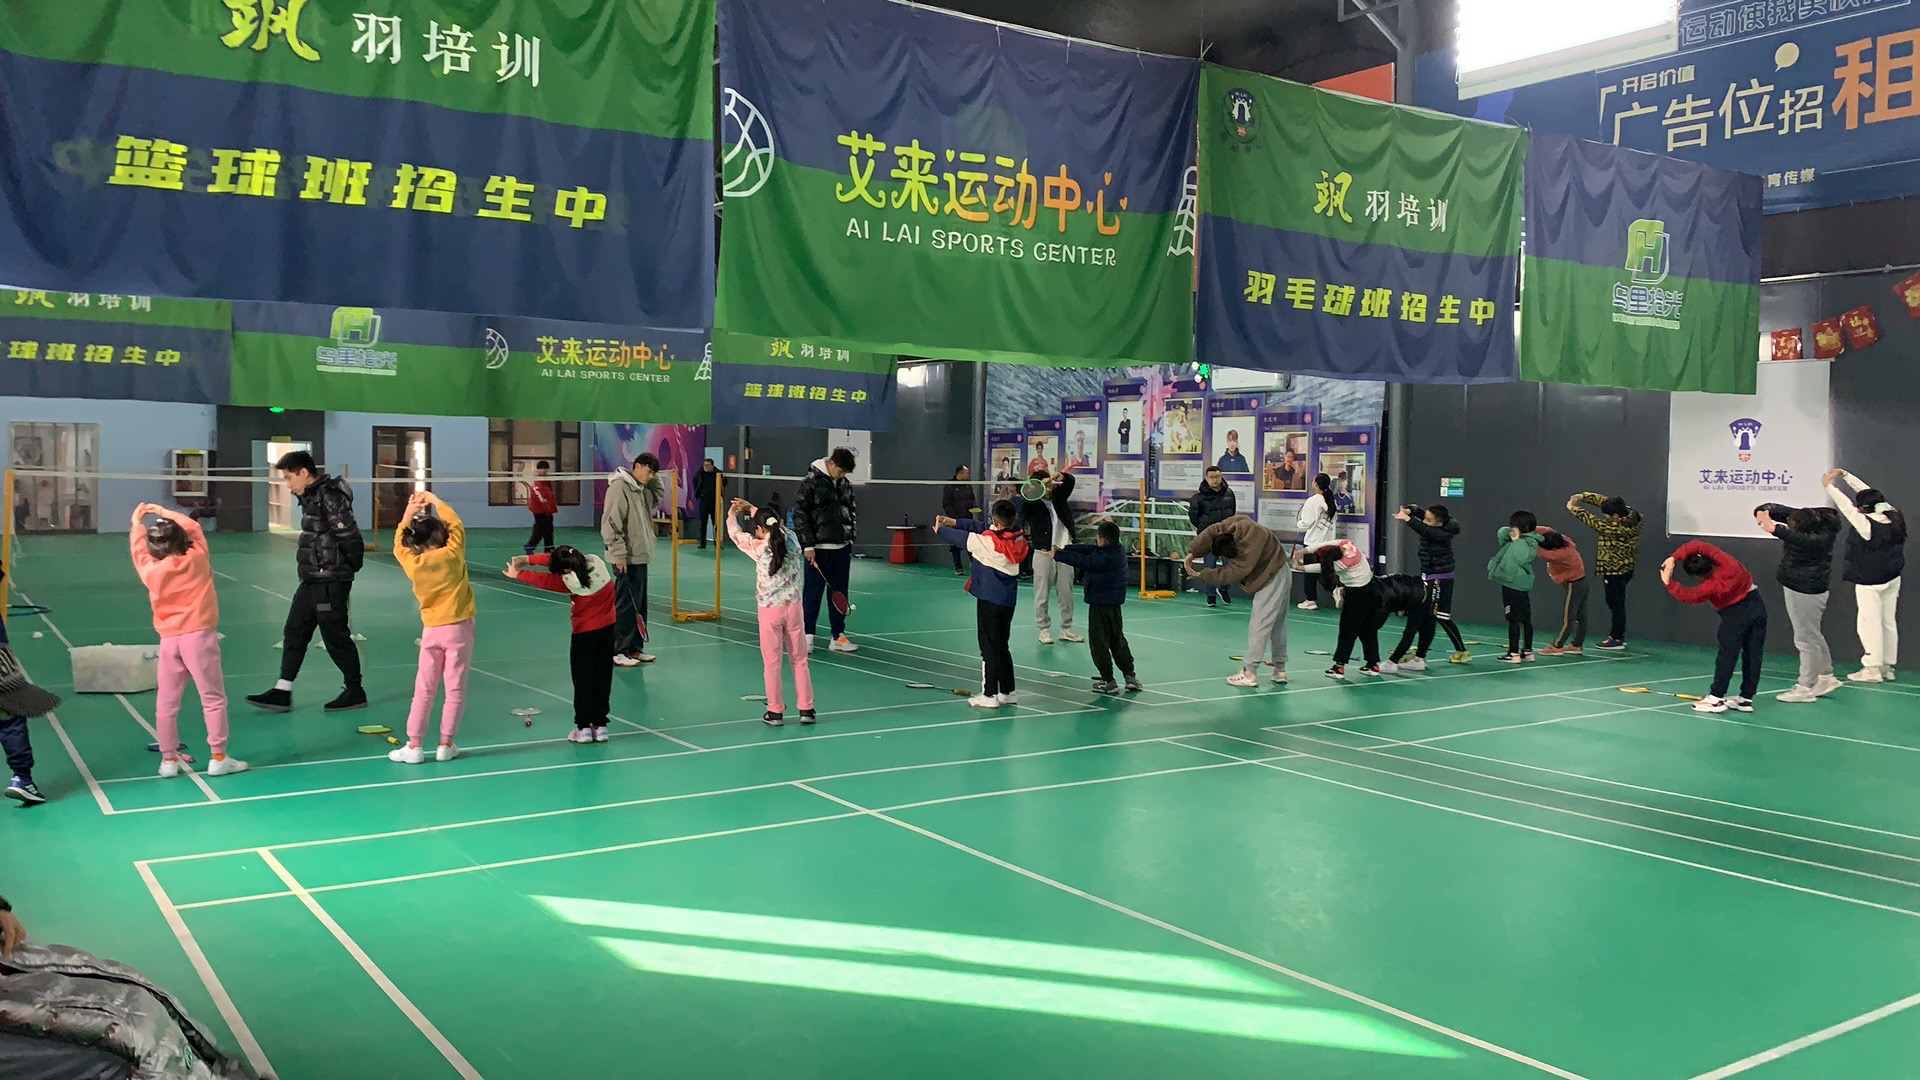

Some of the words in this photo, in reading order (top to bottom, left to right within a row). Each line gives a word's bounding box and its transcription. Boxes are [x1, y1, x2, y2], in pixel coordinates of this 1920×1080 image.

[1681, 0, 1882, 46] 运动使我更
[1621, 64, 1695, 95] 开启价值
[106, 135, 607, 229] 篮球班招生中
[836, 130, 1129, 236] 艾来运动中心
[846, 217, 870, 240] AI
[882, 221, 920, 245] LAI
[931, 229, 1025, 259] SPORTS
[1033, 242, 1118, 268] CENTER
[1243, 270, 1495, 326] 羽毛球班招生中
[0, 340, 181, 366] 球班招生中
[536, 335, 675, 371] 艾来运动中心
[541, 368, 553, 377] AI
[557, 368, 576, 379] LAI
[580, 370, 625, 381] SPORTS
[629, 372, 670, 383] CENTER
[744, 382, 867, 403] 篮球班招生中
[1699, 469, 1793, 485] 艾来运动中心
